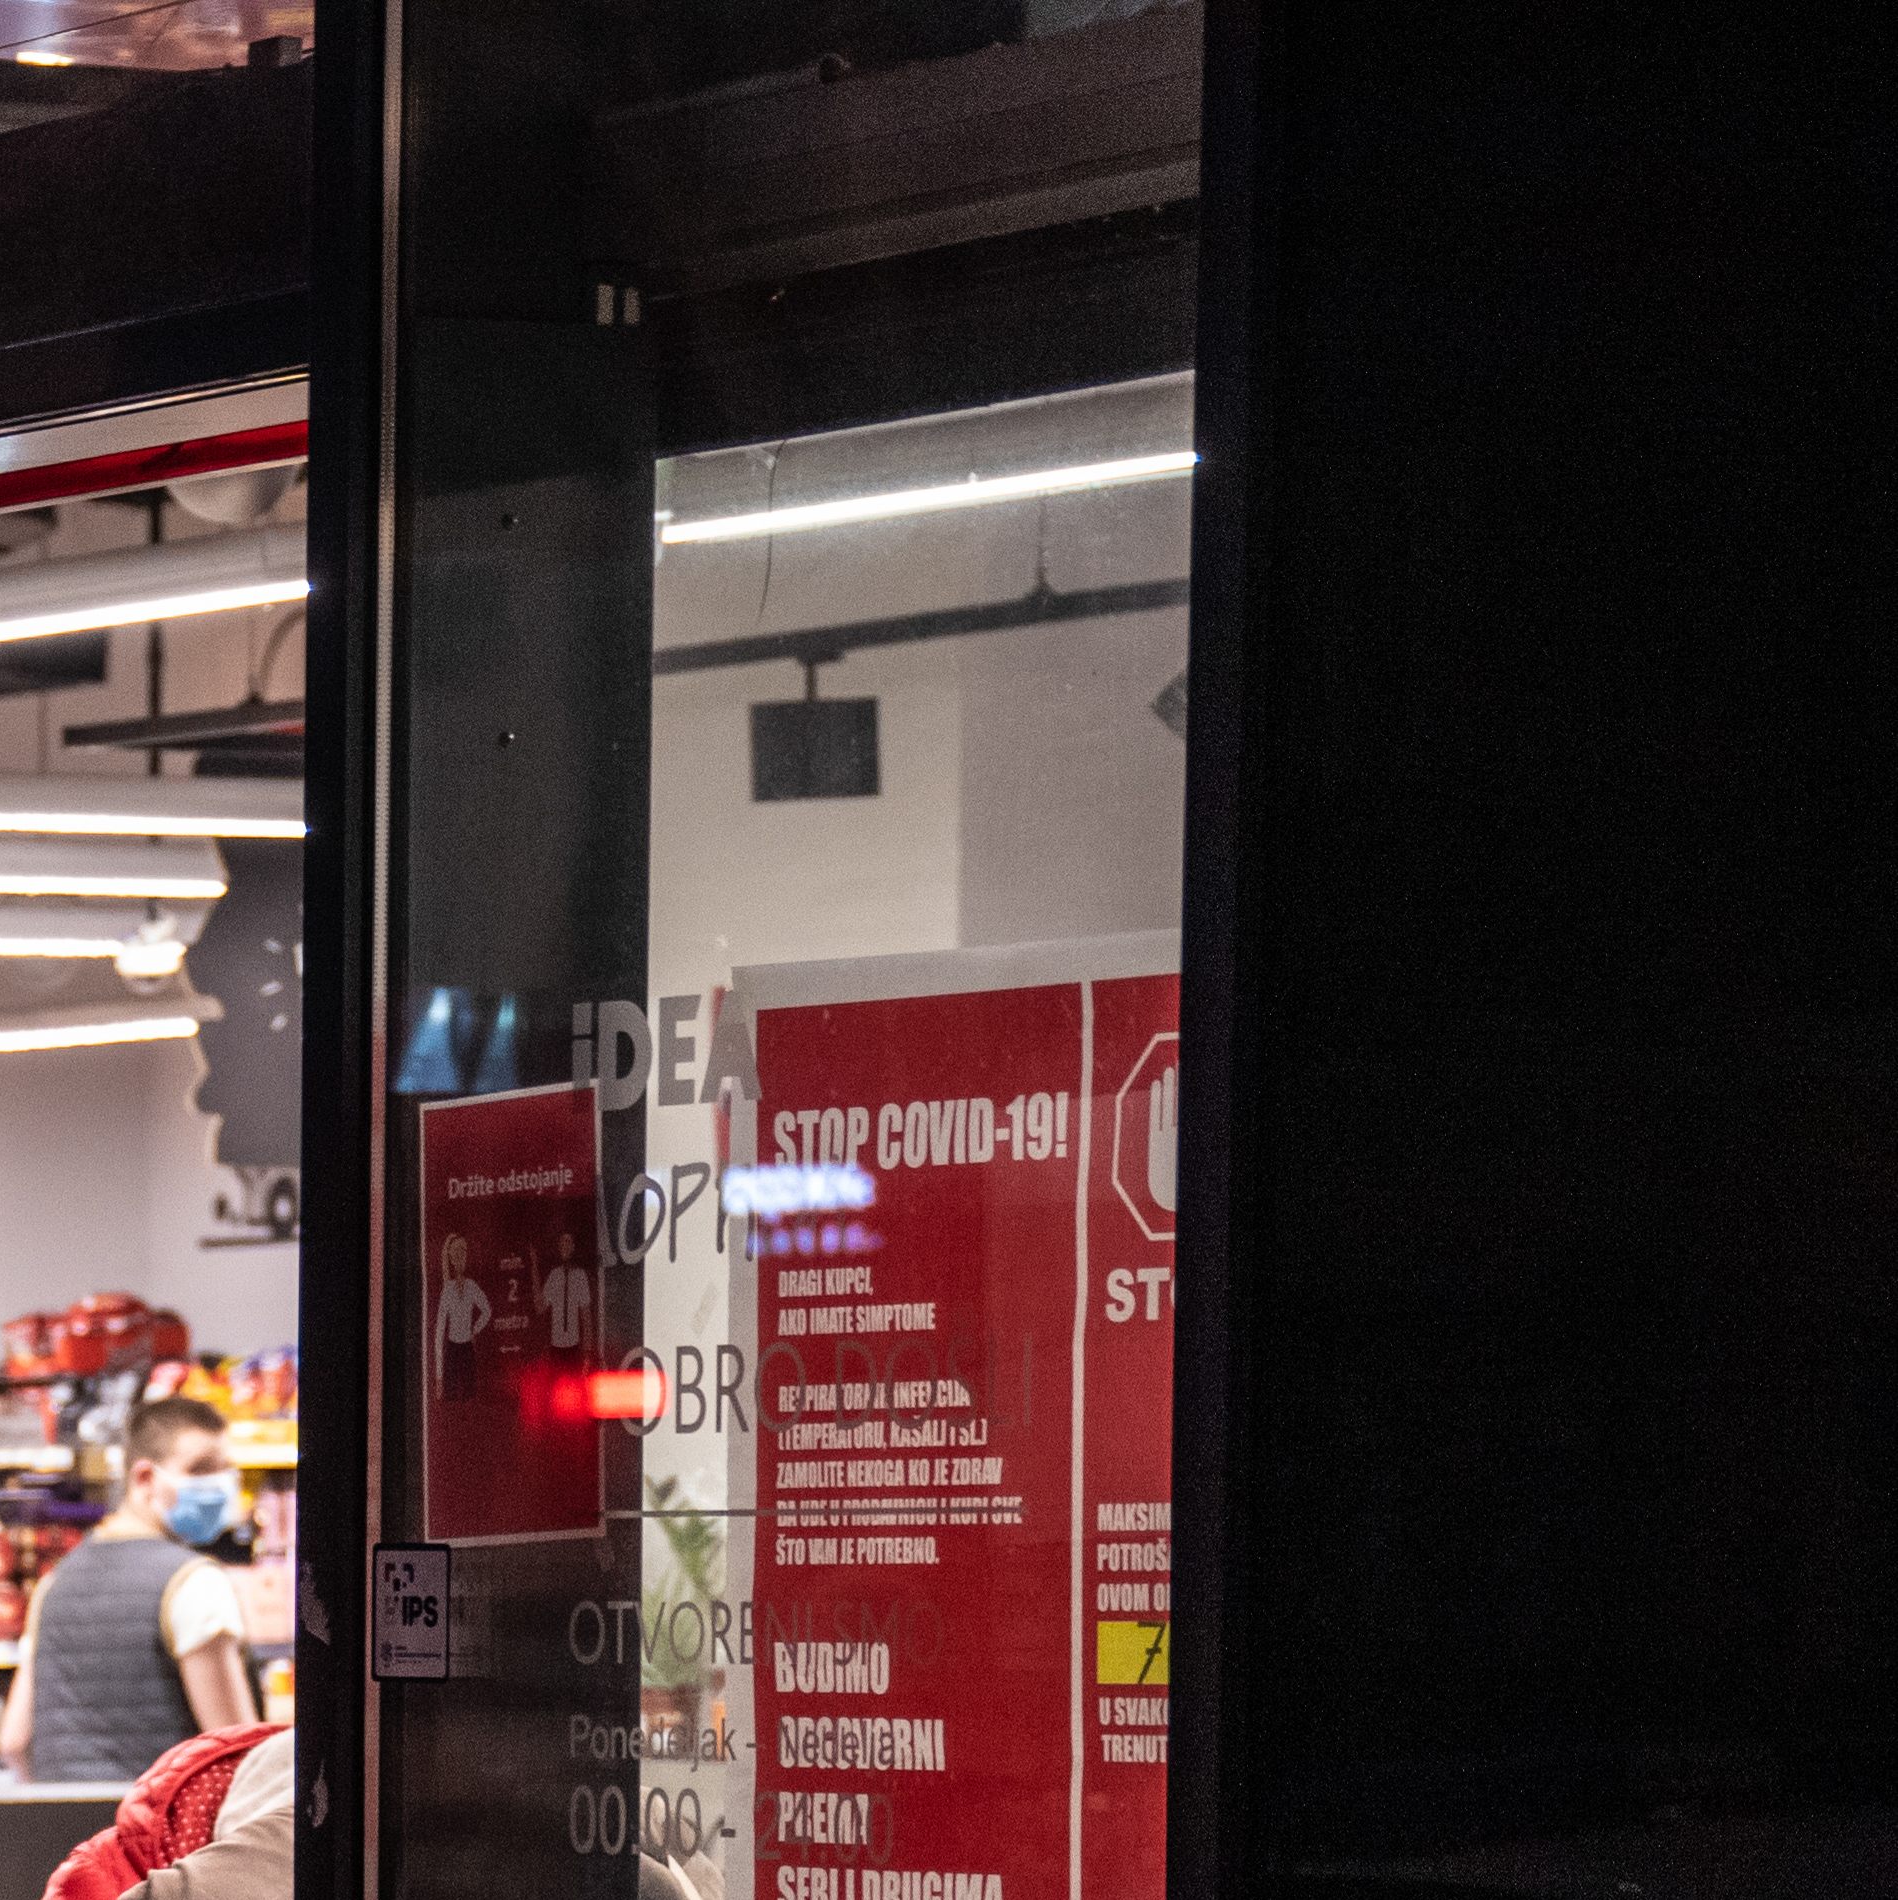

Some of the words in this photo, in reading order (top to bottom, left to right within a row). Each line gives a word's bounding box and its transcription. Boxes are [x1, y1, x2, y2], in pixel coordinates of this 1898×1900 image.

[571, 994, 763, 1112] iDEA
[773, 1105, 870, 1172] STOP
[877, 1090, 1070, 1171] COVID-19!
[497, 1162, 574, 1198] odstojanje
[507, 1277, 519, 1303] 2
[778, 1268, 823, 1298] DRAGI
[1104, 1266, 1176, 1325] ST
[778, 1307, 809, 1337] AKO
[810, 1305, 854, 1336] IMATE
[856, 1302, 937, 1334] SIMPTOME
[776, 1460, 845, 1490] ZAMOLITE
[847, 1459, 905, 1488] NEKOGA
[907, 1458, 931, 1488] KO
[932, 1458, 949, 1487] JE
[951, 1457, 1004, 1487] ZDRAV
[775, 1533, 806, 1566] ŠTO
[808, 1537, 839, 1566] VAM
[840, 1537, 855, 1565] JE
[857, 1535, 941, 1565] POTREBNO.
[401, 1595, 440, 1628] IPS
[1096, 1582, 1151, 1613] OVOM
[773, 1641, 890, 1695] BUDIMO
[1098, 1696, 1112, 1726] U
[569, 1784, 703, 1857] 00.00
